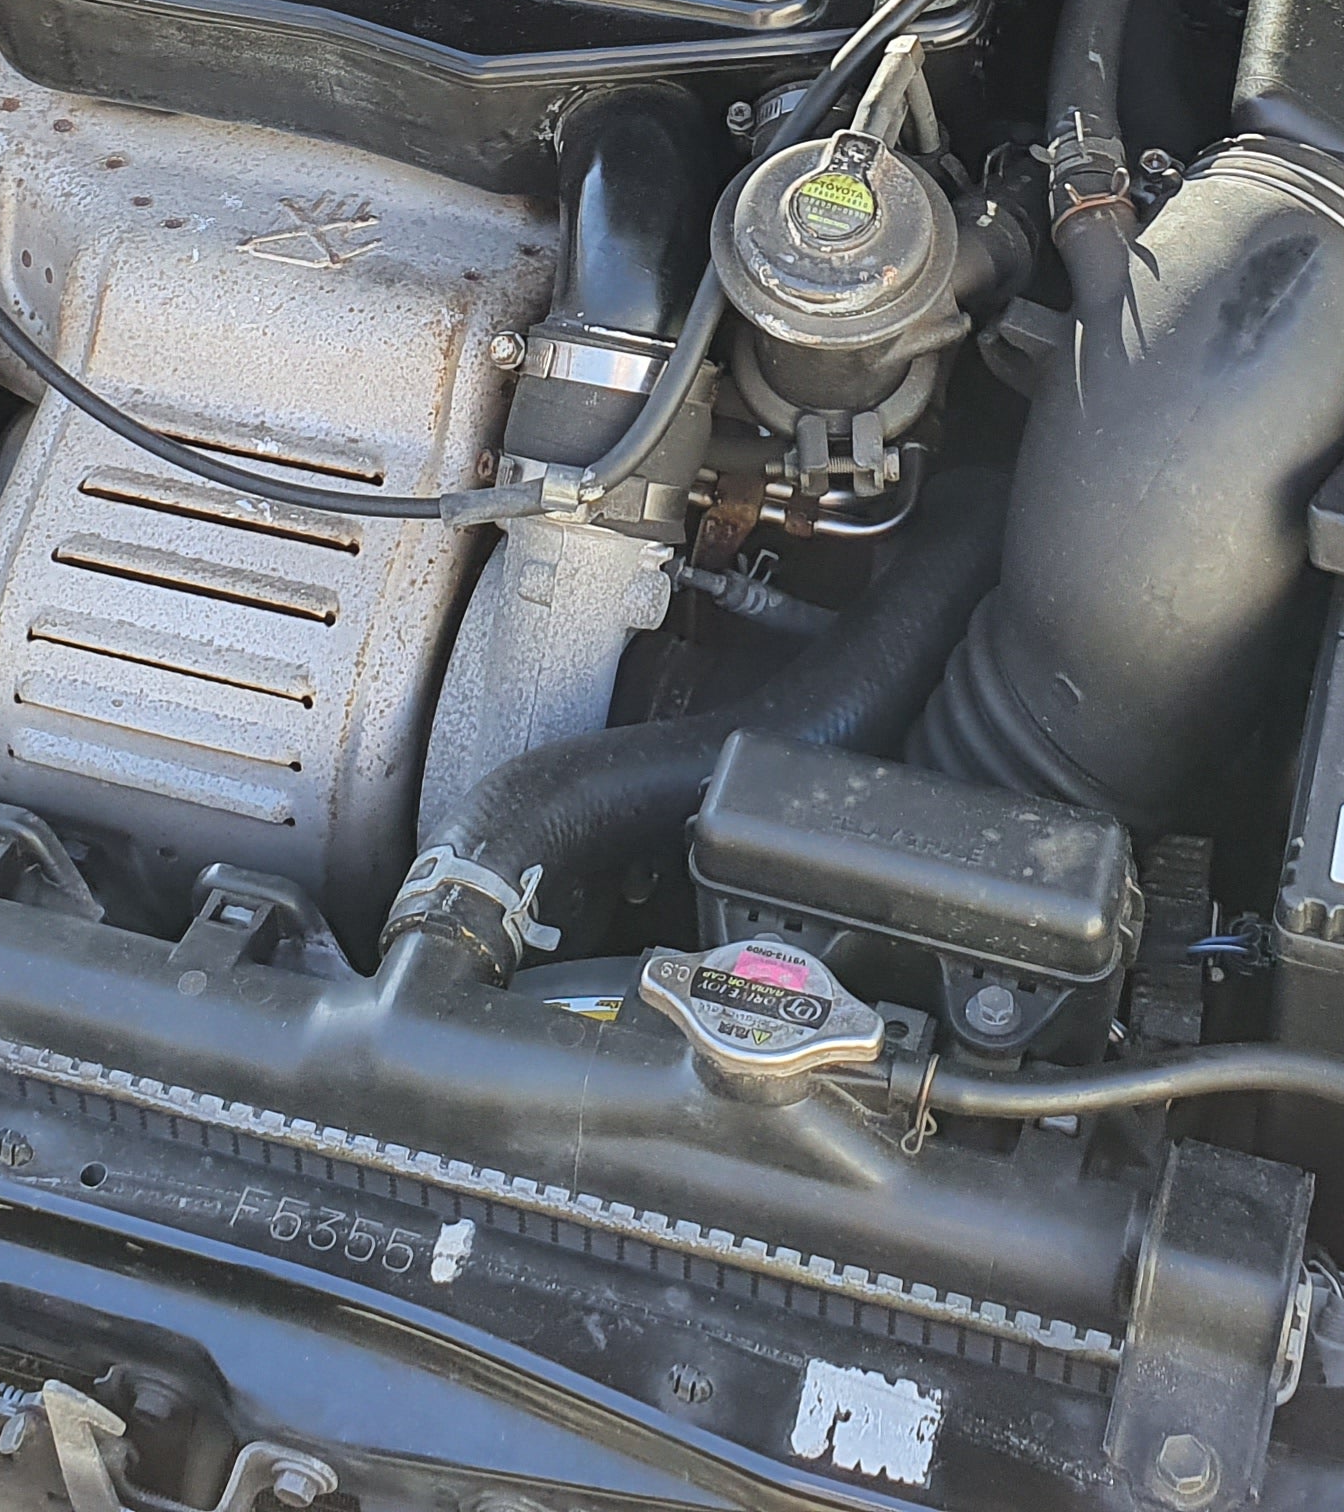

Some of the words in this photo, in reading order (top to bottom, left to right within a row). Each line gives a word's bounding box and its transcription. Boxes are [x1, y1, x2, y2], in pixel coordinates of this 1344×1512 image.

[820, 181, 863, 199] TOYOTA
[702, 971, 727, 982] CAP
[727, 976, 786, 997] RADIATOR
[226, 1186, 422, 1276] F5355
